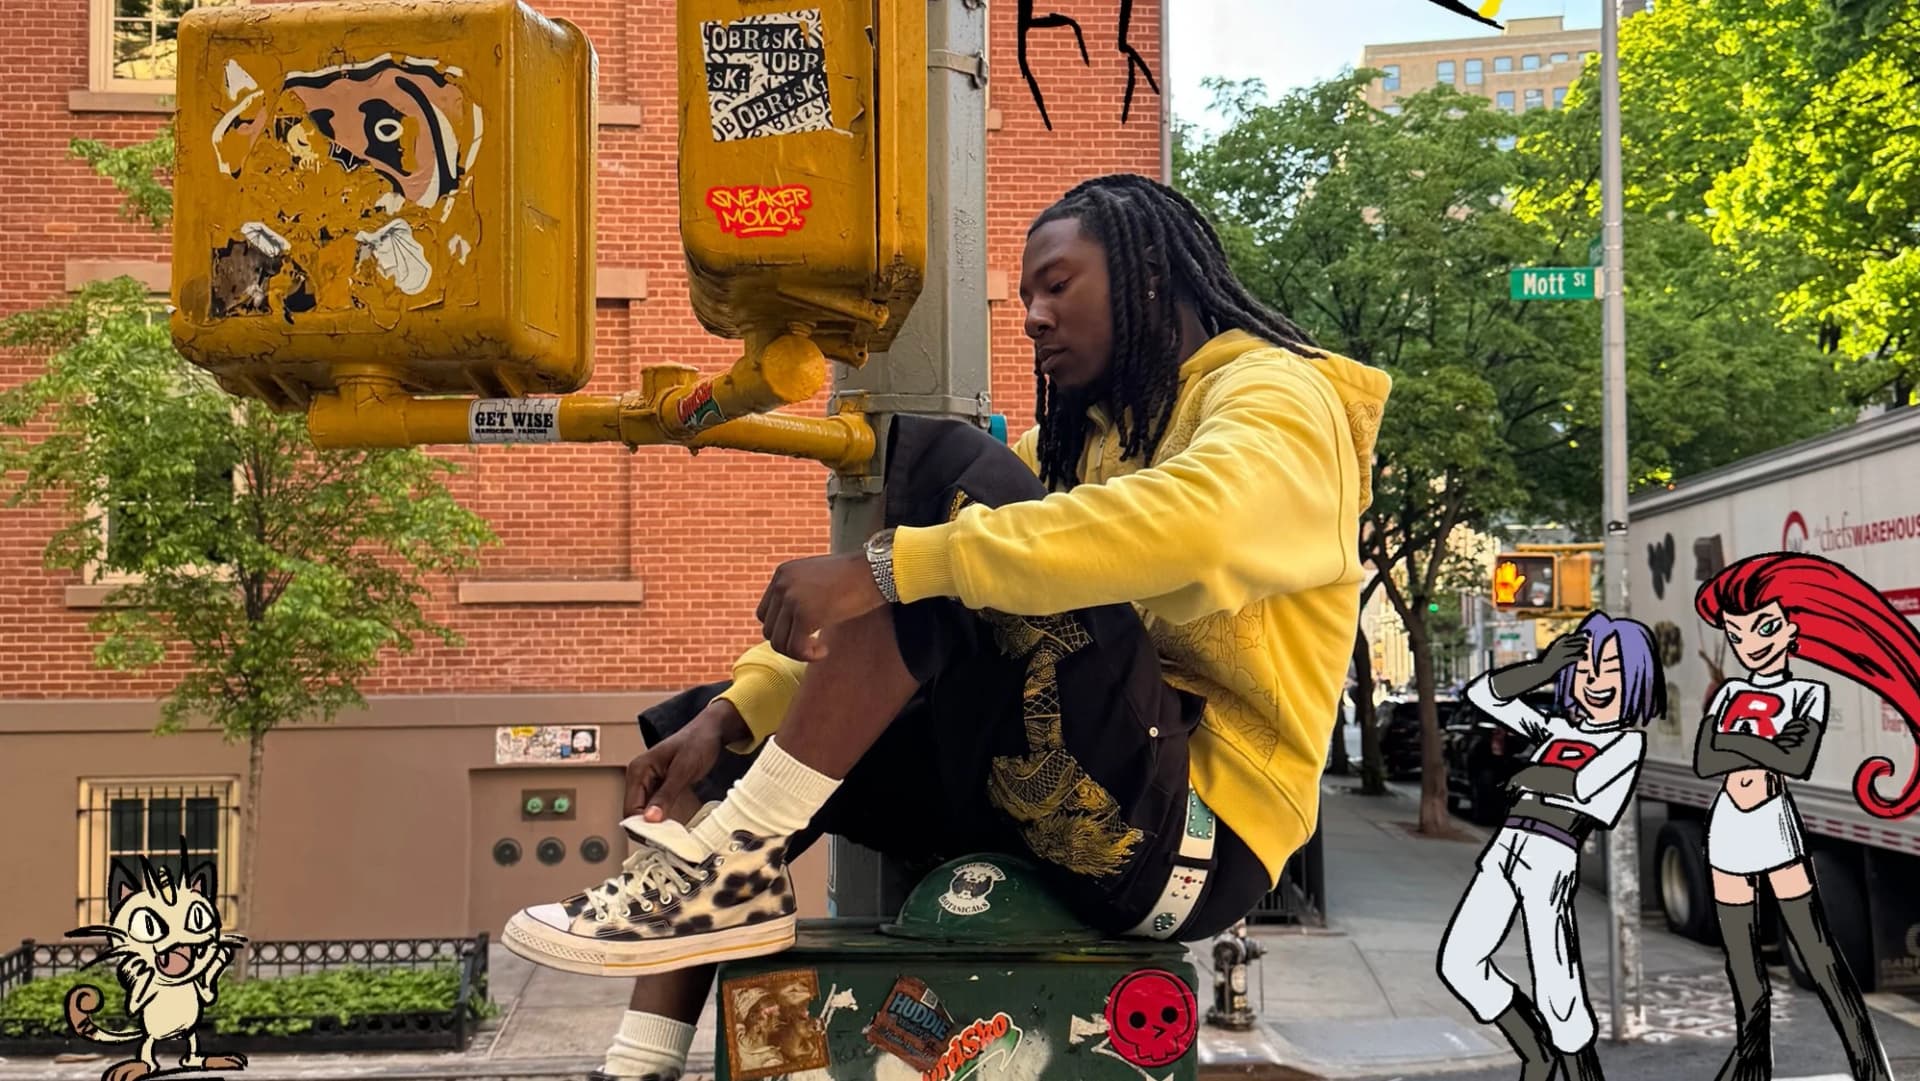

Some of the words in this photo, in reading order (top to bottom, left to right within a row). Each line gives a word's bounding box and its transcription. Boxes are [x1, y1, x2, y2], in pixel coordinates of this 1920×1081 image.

[711, 188, 809, 209] SNEAKER
[1523, 272, 1566, 296] Mott
[1573, 272, 1587, 287] St
[475, 411, 508, 427] GET
[512, 413, 554, 429] WISE
[940, 895, 988, 913] BOTANICALS
[888, 992, 950, 1040] HUDDIE
